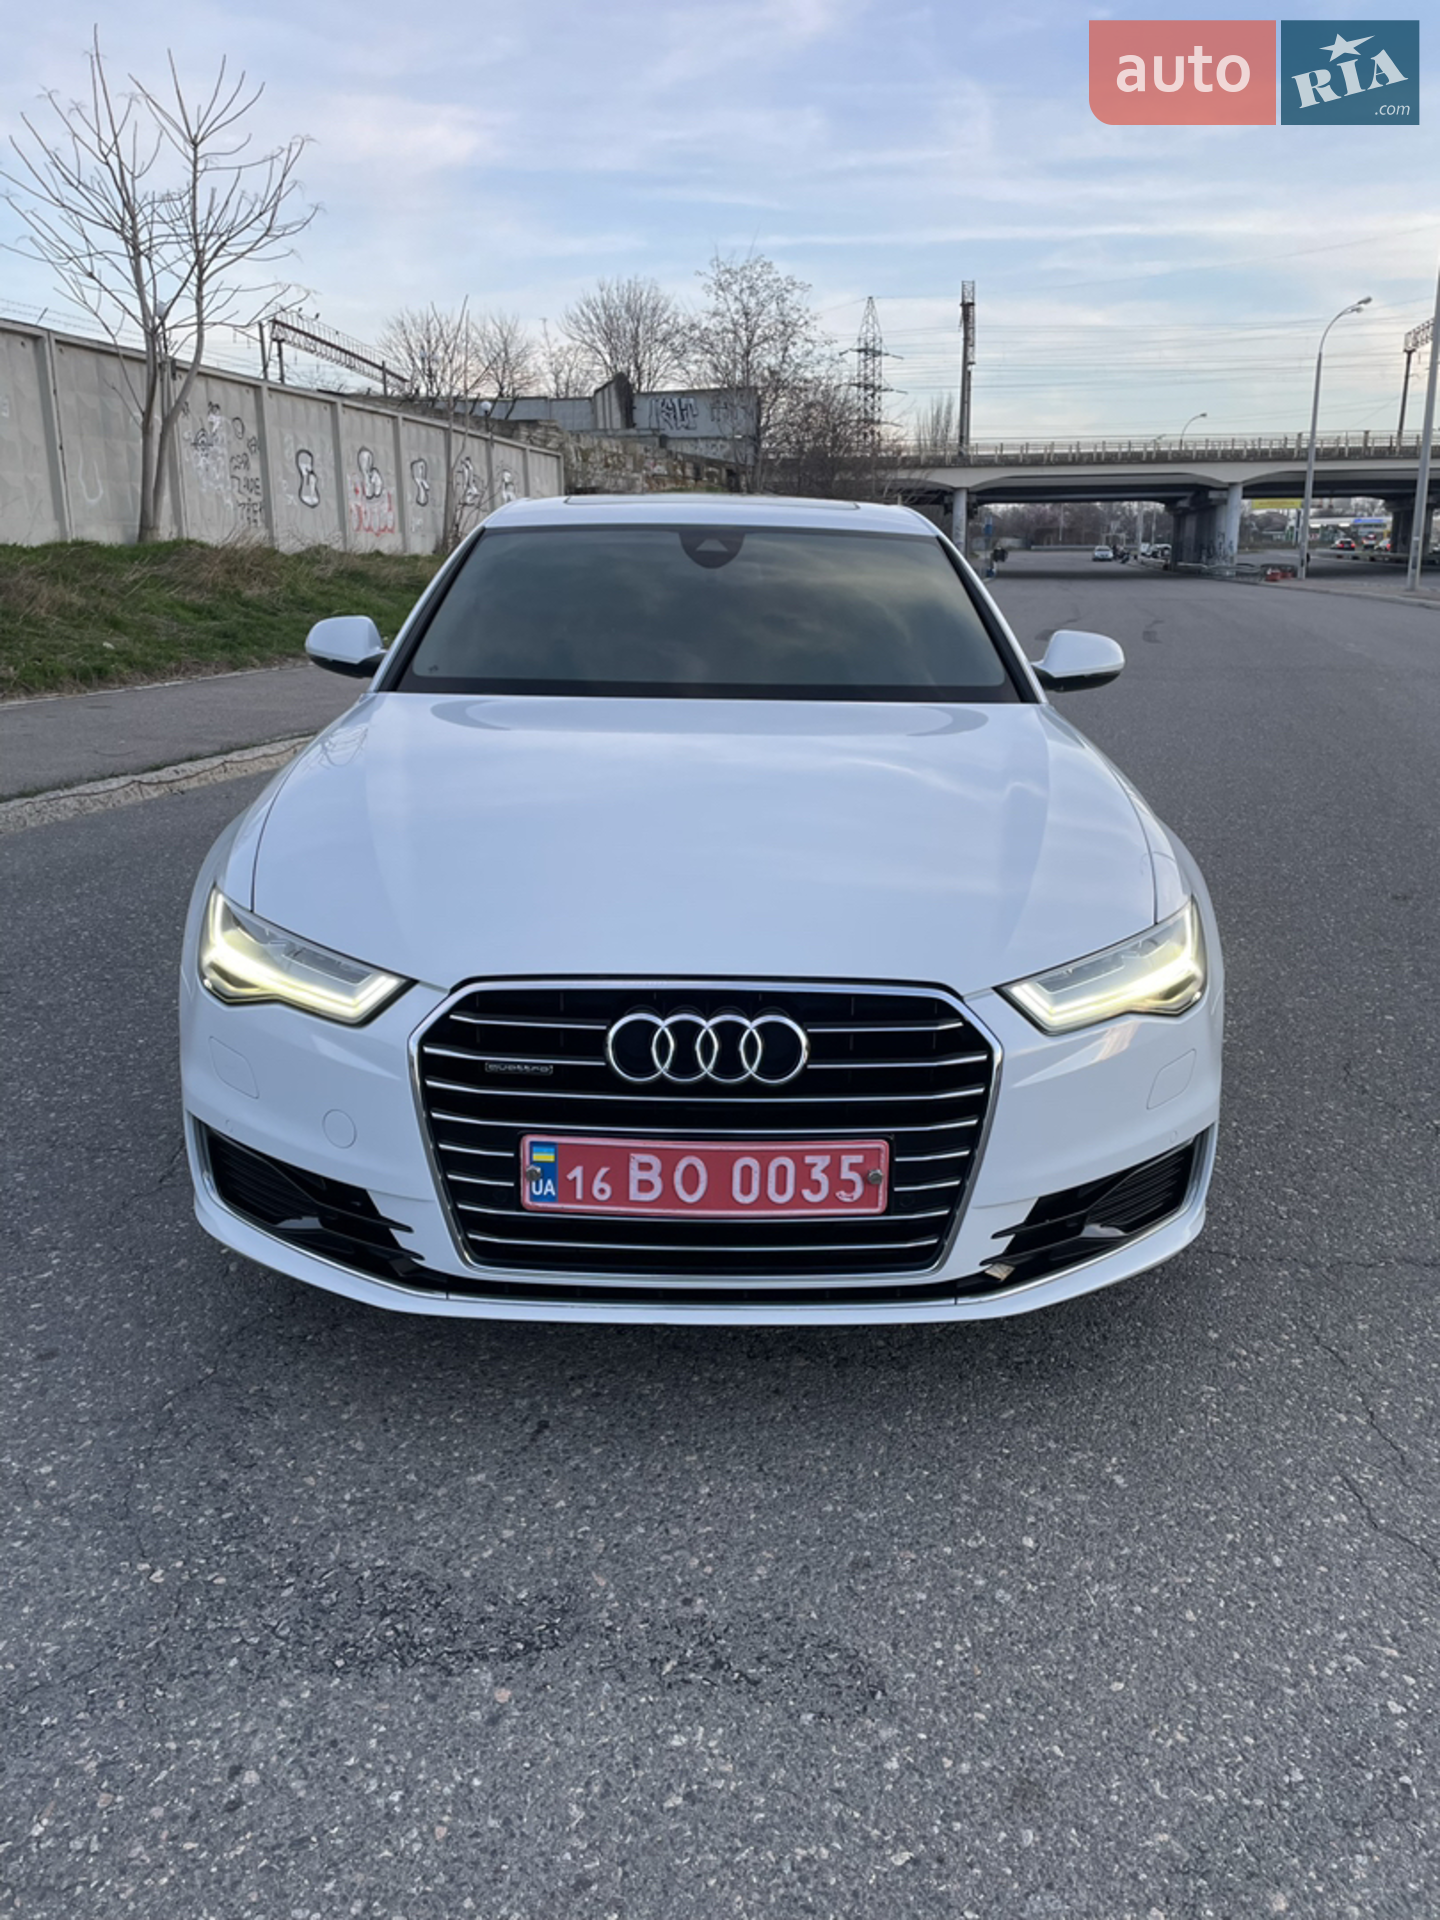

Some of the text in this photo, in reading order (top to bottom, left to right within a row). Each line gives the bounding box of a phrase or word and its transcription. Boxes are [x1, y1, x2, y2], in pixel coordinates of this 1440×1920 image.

[531, 1179, 556, 1196] UA
[566, 1153, 864, 1204] 16 BO 0035
